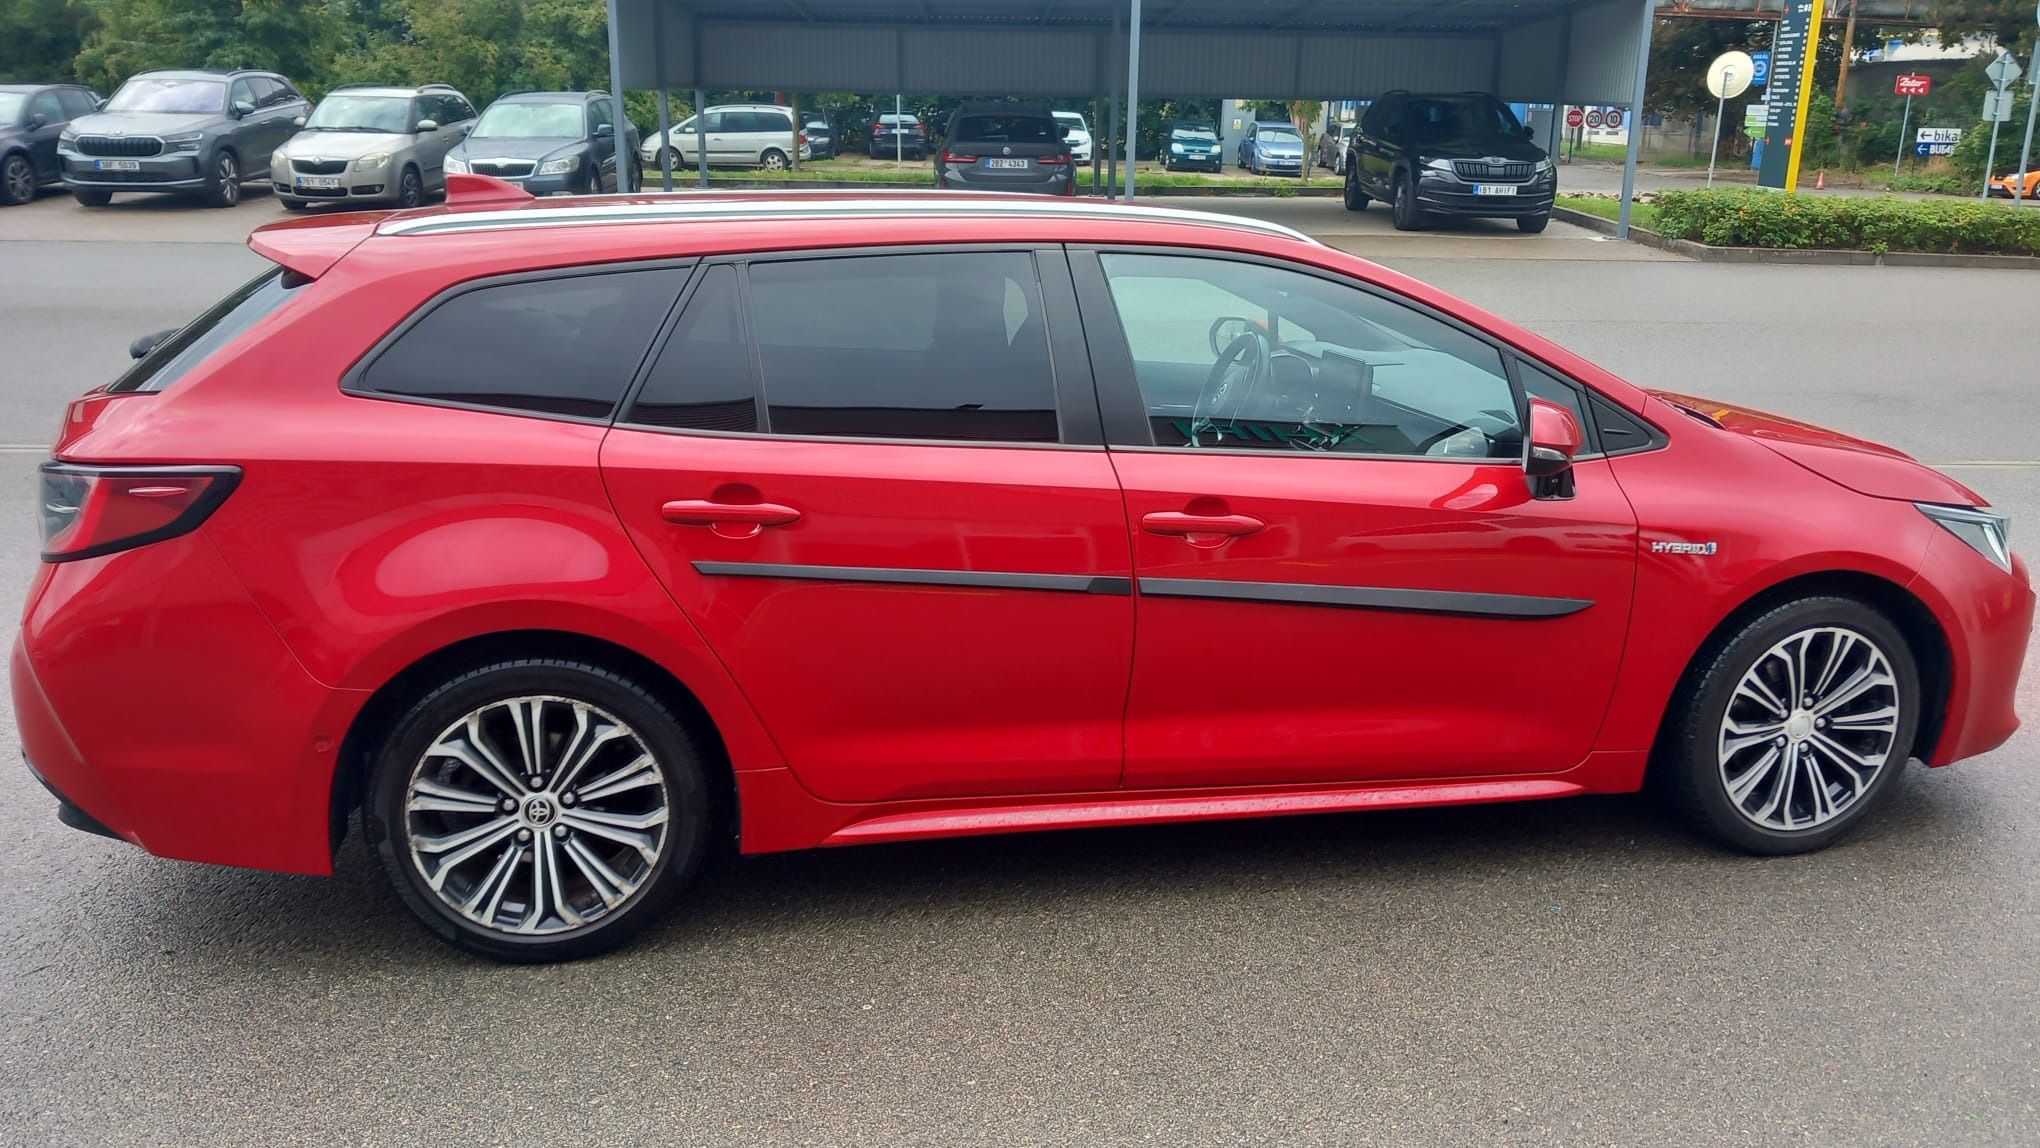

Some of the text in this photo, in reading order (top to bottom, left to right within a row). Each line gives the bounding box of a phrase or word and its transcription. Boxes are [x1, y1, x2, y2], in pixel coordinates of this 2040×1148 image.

[1589, 115, 1600, 123] 20
[1610, 115, 1618, 124] 10
[1934, 130, 1959, 142] bika
[1651, 541, 1707, 555] HYBRID
